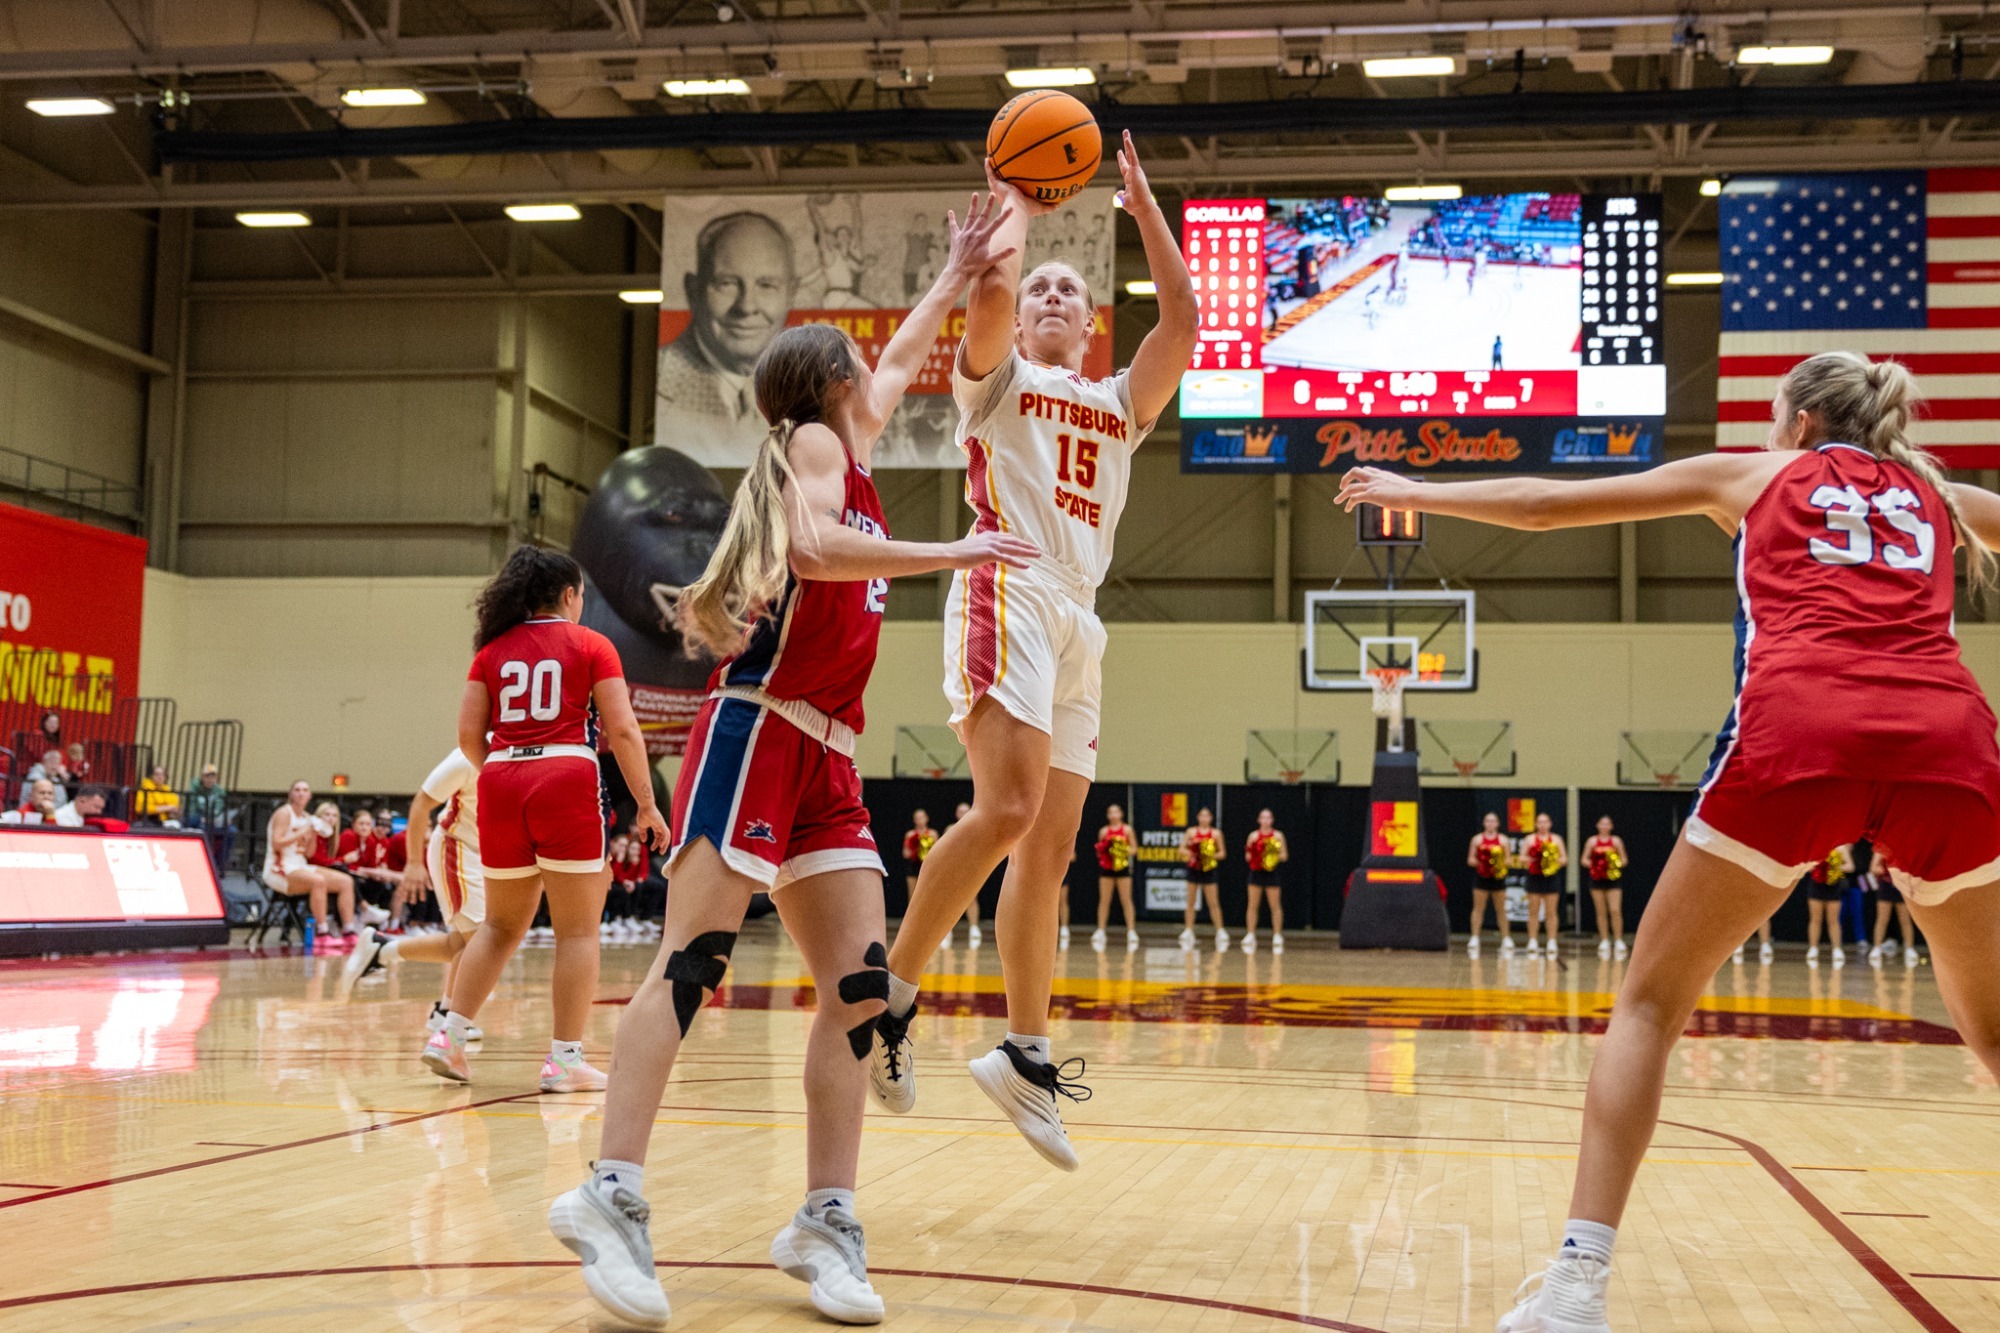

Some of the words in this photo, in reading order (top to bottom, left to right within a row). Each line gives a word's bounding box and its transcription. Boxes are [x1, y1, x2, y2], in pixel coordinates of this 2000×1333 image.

[1184, 206, 1265, 223] GORILLAS
[1605, 198, 1637, 216] JETS
[1518, 378, 1534, 403] 7
[1056, 432, 1101, 491] 15
[1316, 420, 1408, 468] Pitt
[1405, 420, 1522, 467] State
[1054, 484, 1102, 528] STATE
[1808, 483, 1936, 576] 35
[0, 590, 32, 632] TO
[499, 659, 563, 722] 20
